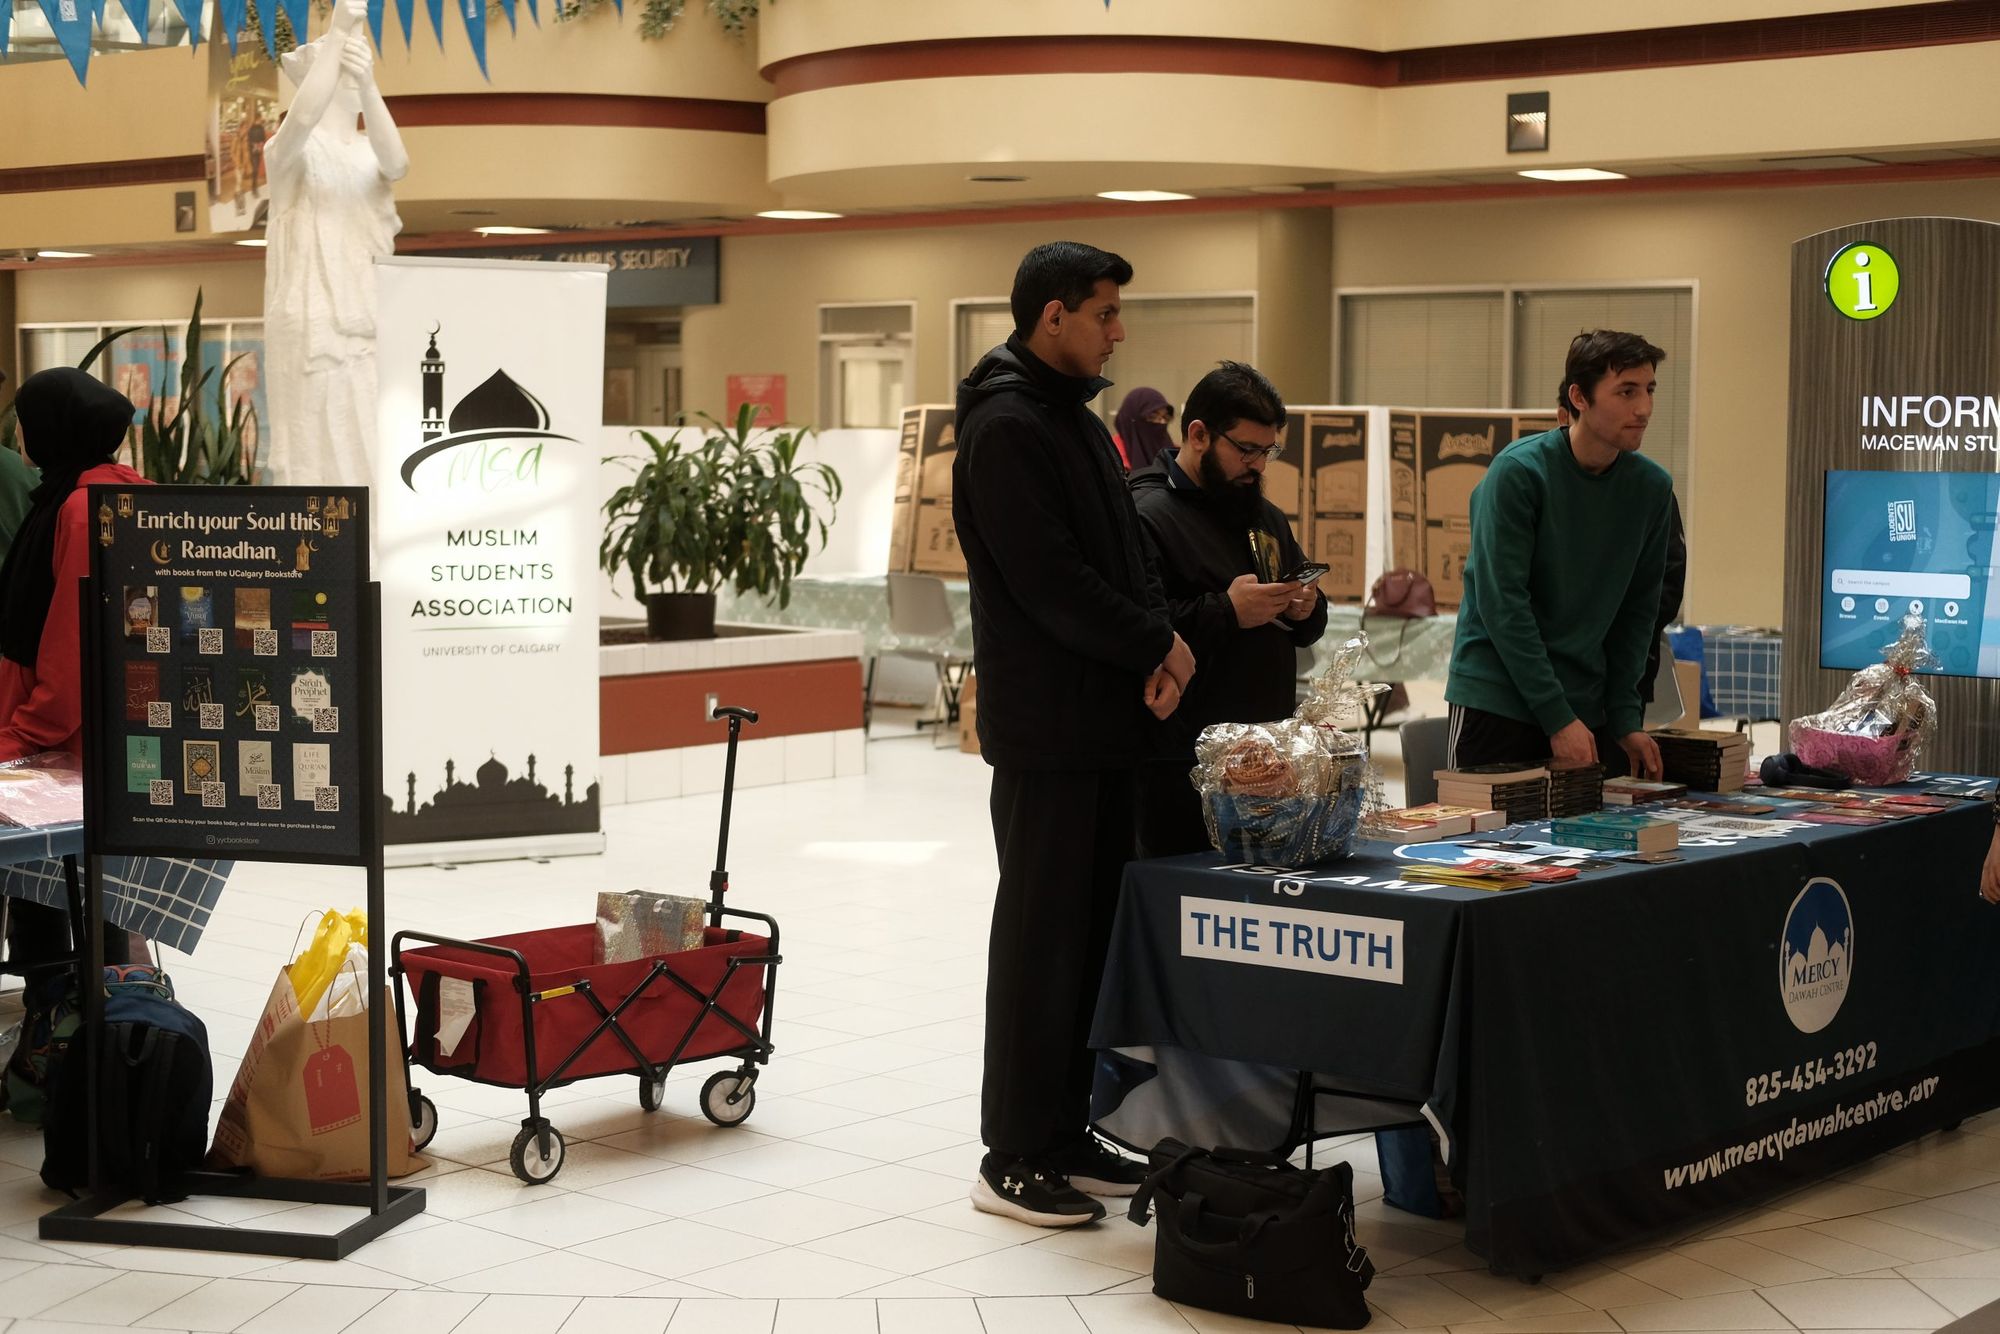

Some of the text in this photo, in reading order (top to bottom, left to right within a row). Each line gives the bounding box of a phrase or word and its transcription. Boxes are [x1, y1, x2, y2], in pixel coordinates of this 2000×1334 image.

[621, 248, 691, 270] SECURITY
[1862, 395, 2000, 428] INFORM
[1862, 434, 2000, 452] MACEWAN STU
[137, 510, 321, 535] Enrich your Soul this
[1888, 501, 1897, 542] STUDENTS
[1897, 503, 1913, 532] SU
[447, 530, 538, 547] MUSLIM
[1896, 533, 1916, 541] UNION
[181, 540, 276, 560] Ramadhan
[172, 569, 195, 577] books
[197, 569, 214, 577] from
[215, 569, 227, 577] the
[229, 569, 263, 579] UCalgary
[265, 570, 302, 578] Bookstore
[431, 563, 554, 582] STUDENTS
[411, 597, 573, 617] ASSOCIATION
[423, 643, 561, 657] UNIVERSITY OF CALGARY
[217, 837, 259, 845] yycbookstore
[1209, 863, 1449, 892] ISLAM
[1190, 911, 1393, 969] THE TRUTH
[1792, 956, 1841, 988] MERCY
[1788, 979, 1845, 1004] DAWAH CENTRE
[1745, 1040, 1878, 1107] 825-454-3292
